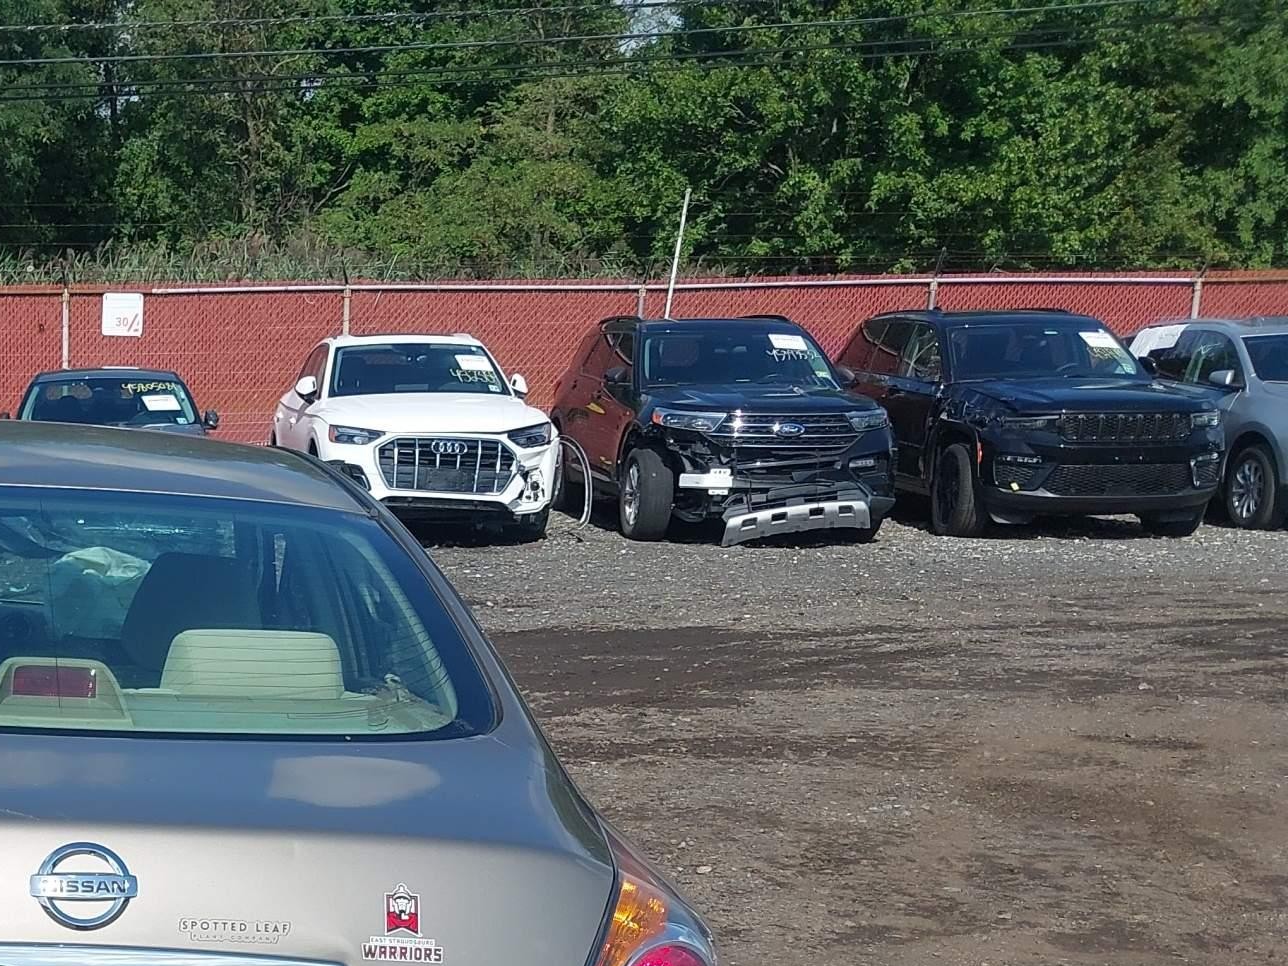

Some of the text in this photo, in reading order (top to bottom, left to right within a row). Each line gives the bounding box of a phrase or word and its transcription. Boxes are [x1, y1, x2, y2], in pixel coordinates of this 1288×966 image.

[182, 920, 288, 933] SPOTTED LEAF
[363, 944, 442, 961] WARRIORS
